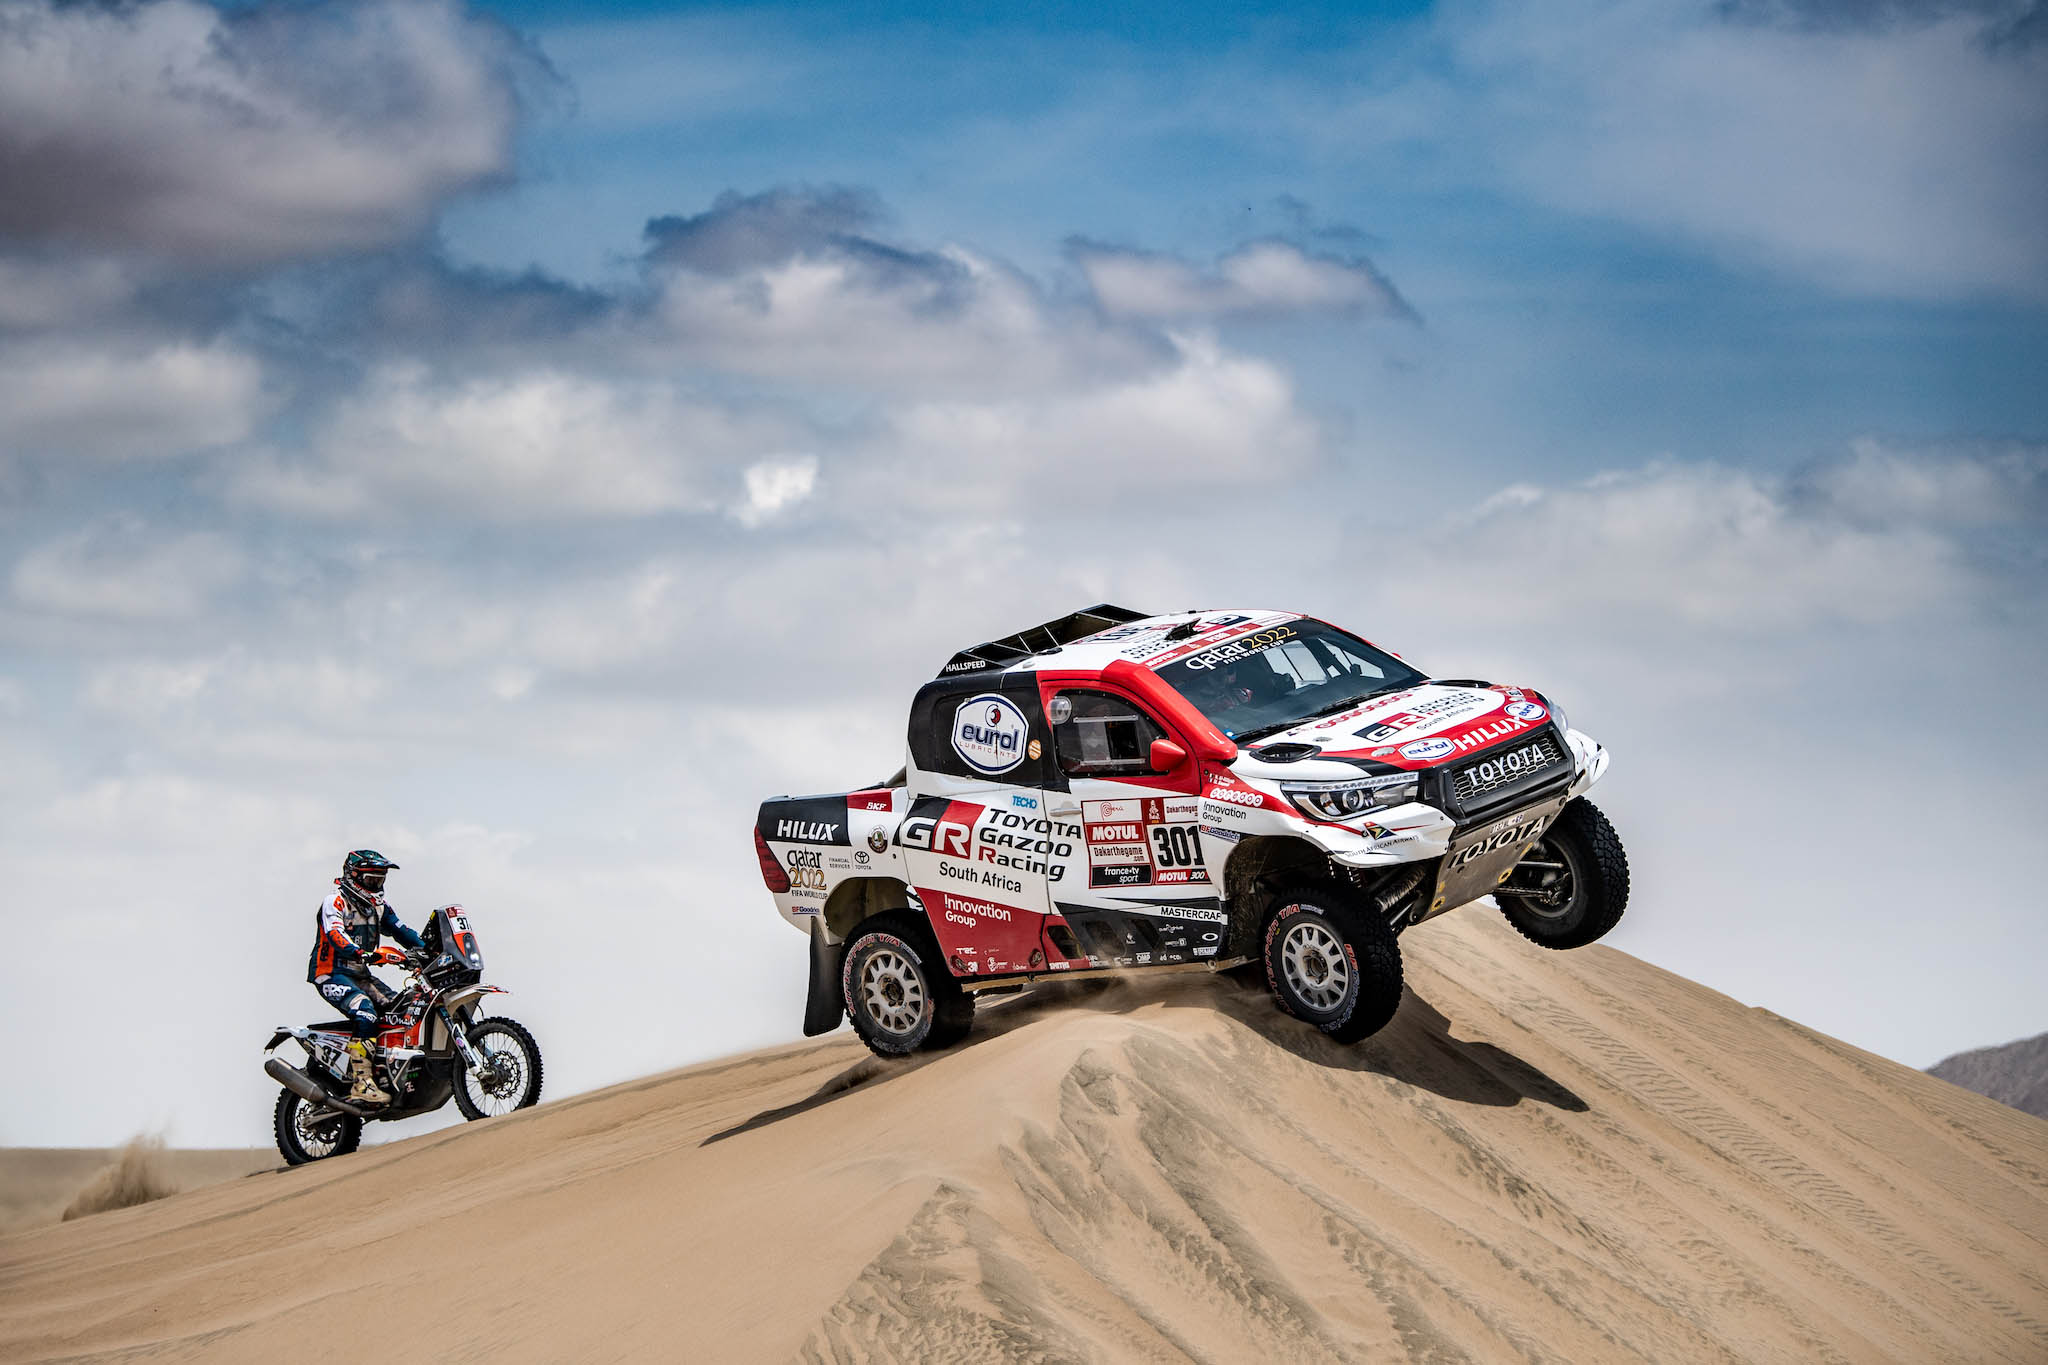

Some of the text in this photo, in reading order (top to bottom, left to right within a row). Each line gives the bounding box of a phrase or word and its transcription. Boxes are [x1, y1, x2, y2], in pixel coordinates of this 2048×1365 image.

[1241, 626, 1297, 649] 2022
[1223, 640, 1285, 665] FIFA WORLD CUP
[945, 660, 986, 672] HALLSPEED
[962, 723, 1020, 752] eurol
[1453, 716, 1529, 752] HILUX
[959, 741, 1017, 760] LUBRICANTS
[1408, 740, 1449, 755] eurol
[1464, 743, 1545, 786] TOYOTA
[866, 802, 887, 811] SKF
[1012, 795, 1037, 810] TECHO
[1203, 801, 1247, 820] Innovation
[989, 808, 1082, 839] TOYOTA
[1202, 812, 1222, 824] Group
[777, 819, 840, 841] HILUX
[902, 816, 971, 857] GR
[1092, 825, 1139, 841] MOTUL
[979, 827, 1073, 857] GAZOO
[1093, 846, 1143, 857] Dakarthegame
[1153, 825, 1205, 867] 301
[1448, 815, 1547, 868] TOYOTA
[978, 845, 1067, 882] Racing
[788, 867, 827, 891] 2022
[939, 861, 1022, 893] South Africa
[1119, 874, 1139, 883] sport
[1158, 871, 1188, 882] MOTUL
[791, 890, 804, 898] FIFA
[944, 894, 1012, 922] Innovation
[945, 911, 977, 928] Group
